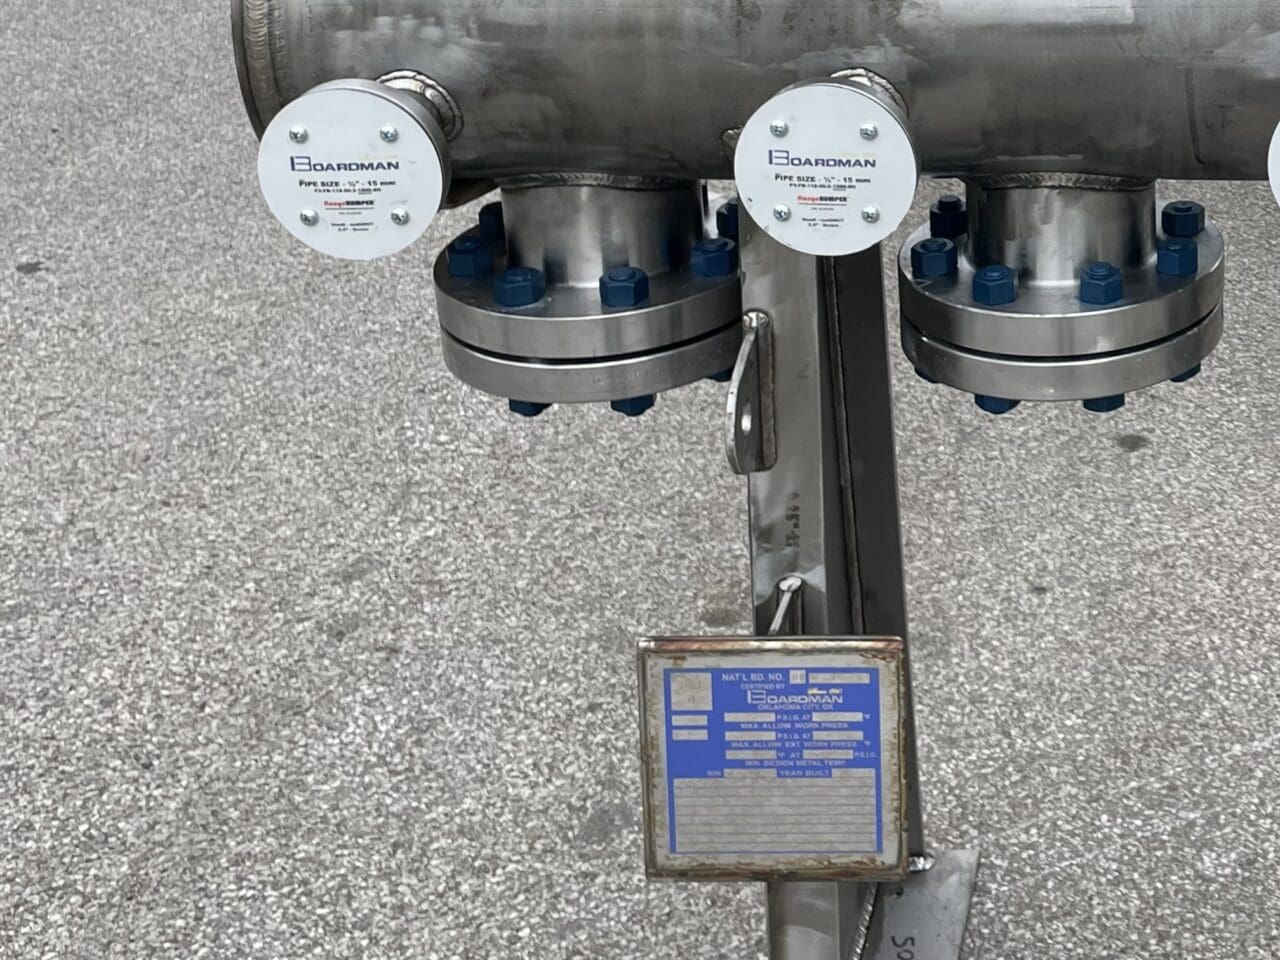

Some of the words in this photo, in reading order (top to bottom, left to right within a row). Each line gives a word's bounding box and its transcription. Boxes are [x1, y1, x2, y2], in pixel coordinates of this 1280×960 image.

[289, 155, 400, 172] BOARDMAN
[768, 149, 876, 168] BOARDMAN
[299, 179, 318, 187] PIPE
[775, 173, 793, 182] PIPE
[721, 673, 748, 682] NAT'L
[750, 673, 766, 682] BD.
[768, 673, 785, 682] NO.
[747, 690, 843, 704] BOARDMAN
